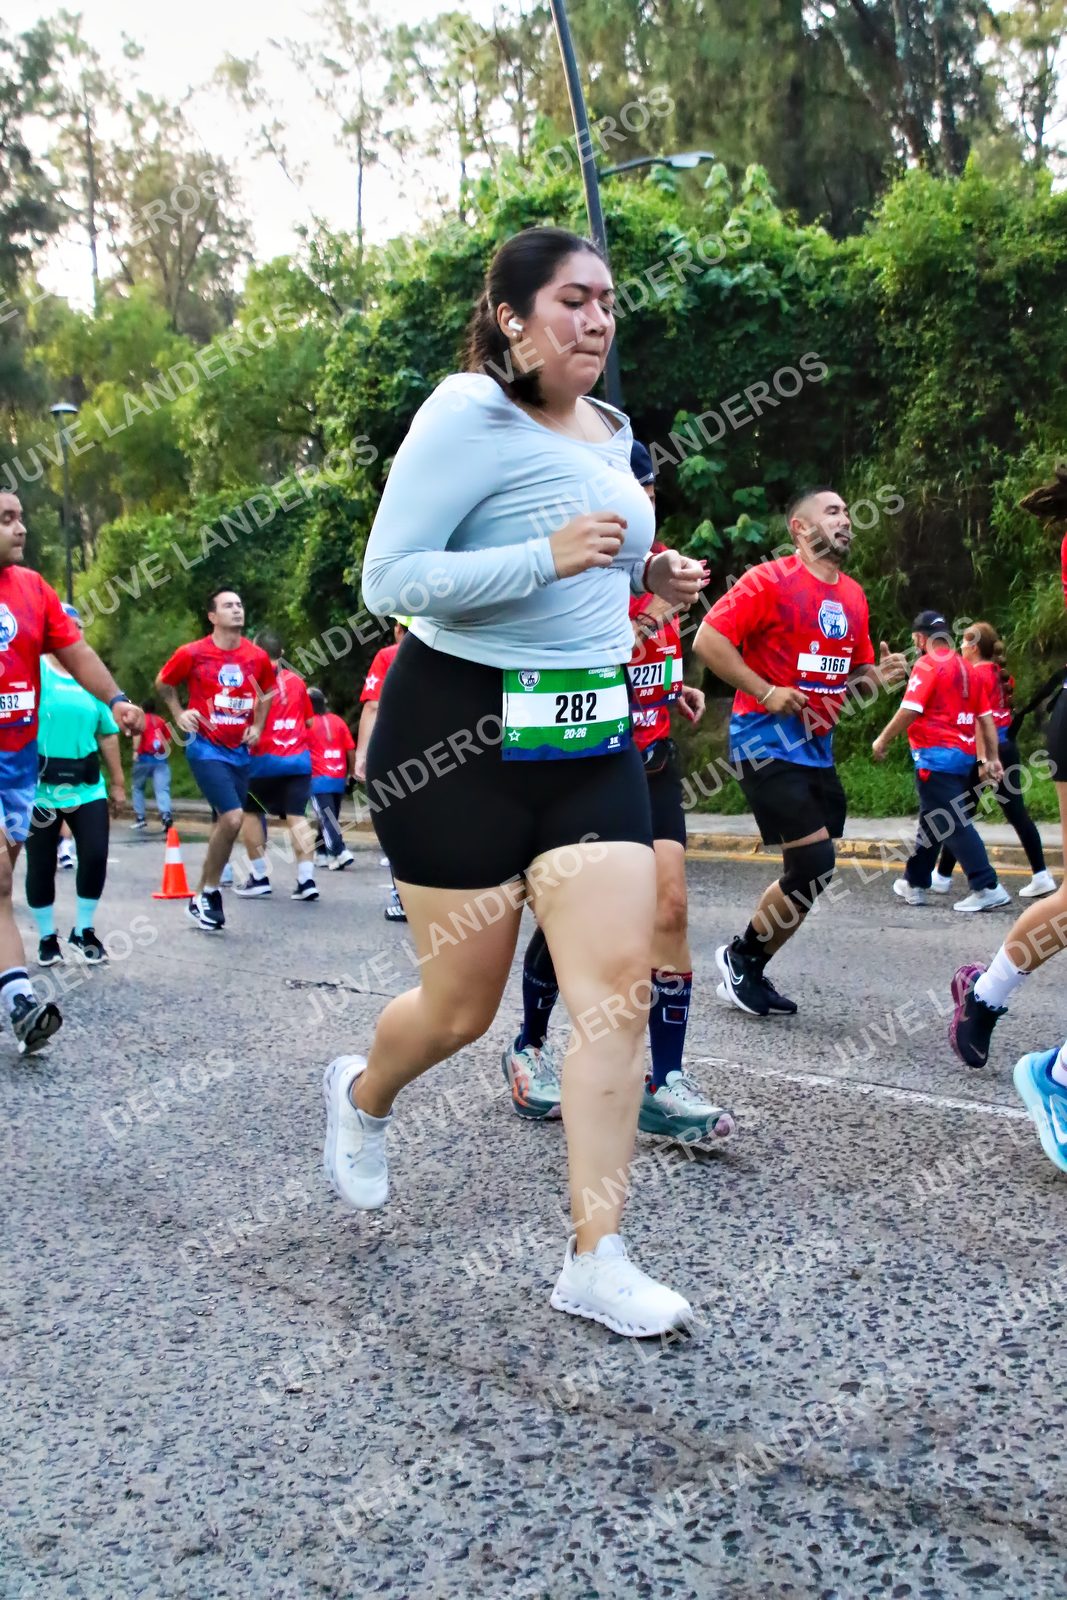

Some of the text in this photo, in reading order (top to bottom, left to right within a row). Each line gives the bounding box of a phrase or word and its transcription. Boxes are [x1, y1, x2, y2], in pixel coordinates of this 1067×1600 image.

[633, 663, 662, 687] 2271
[820, 657, 846, 673] 3166
[555, 692, 597, 724] 282
